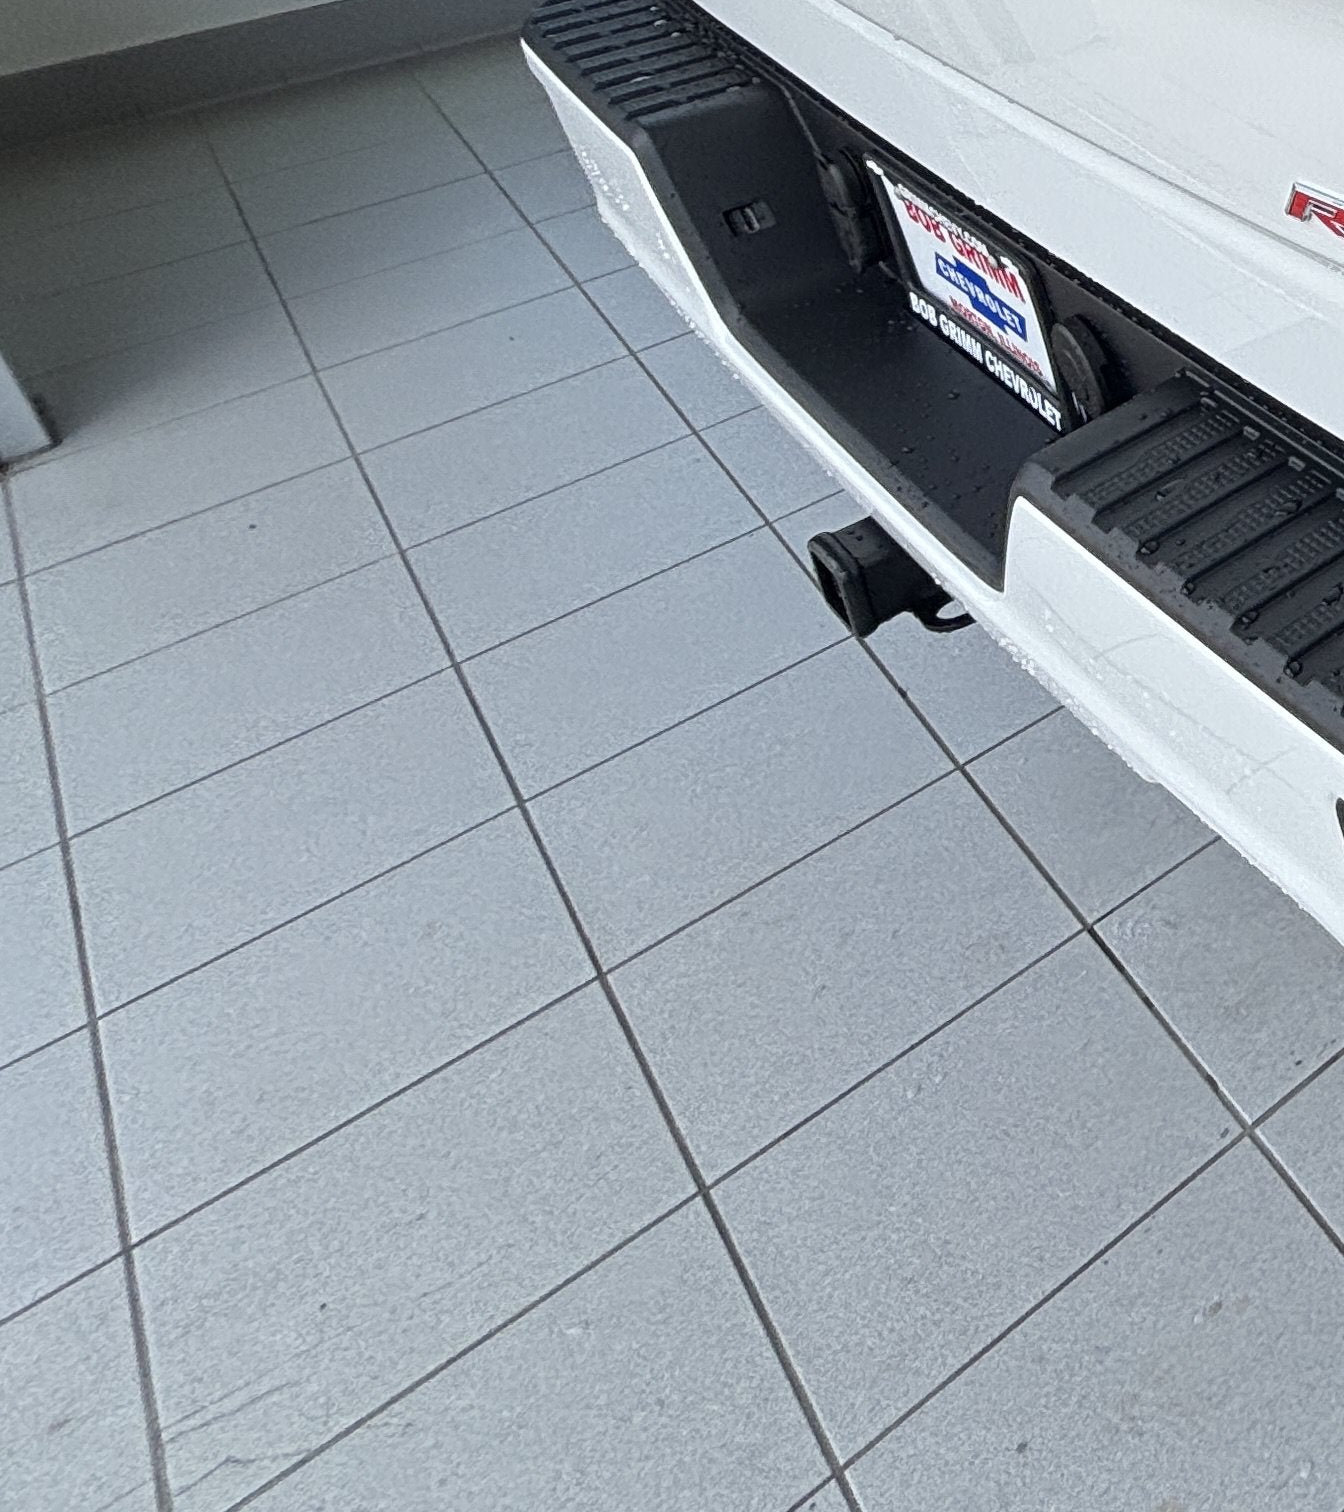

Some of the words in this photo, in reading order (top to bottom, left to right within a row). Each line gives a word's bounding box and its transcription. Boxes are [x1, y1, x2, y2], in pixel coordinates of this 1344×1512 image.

[902, 199, 946, 244] BOB
[948, 231, 1027, 305] GRIMM
[936, 257, 1024, 336] CHEVROLET
[909, 291, 938, 327] BOB
[939, 313, 984, 365] GRIMM
[984, 350, 1062, 432] CHEVROLET
